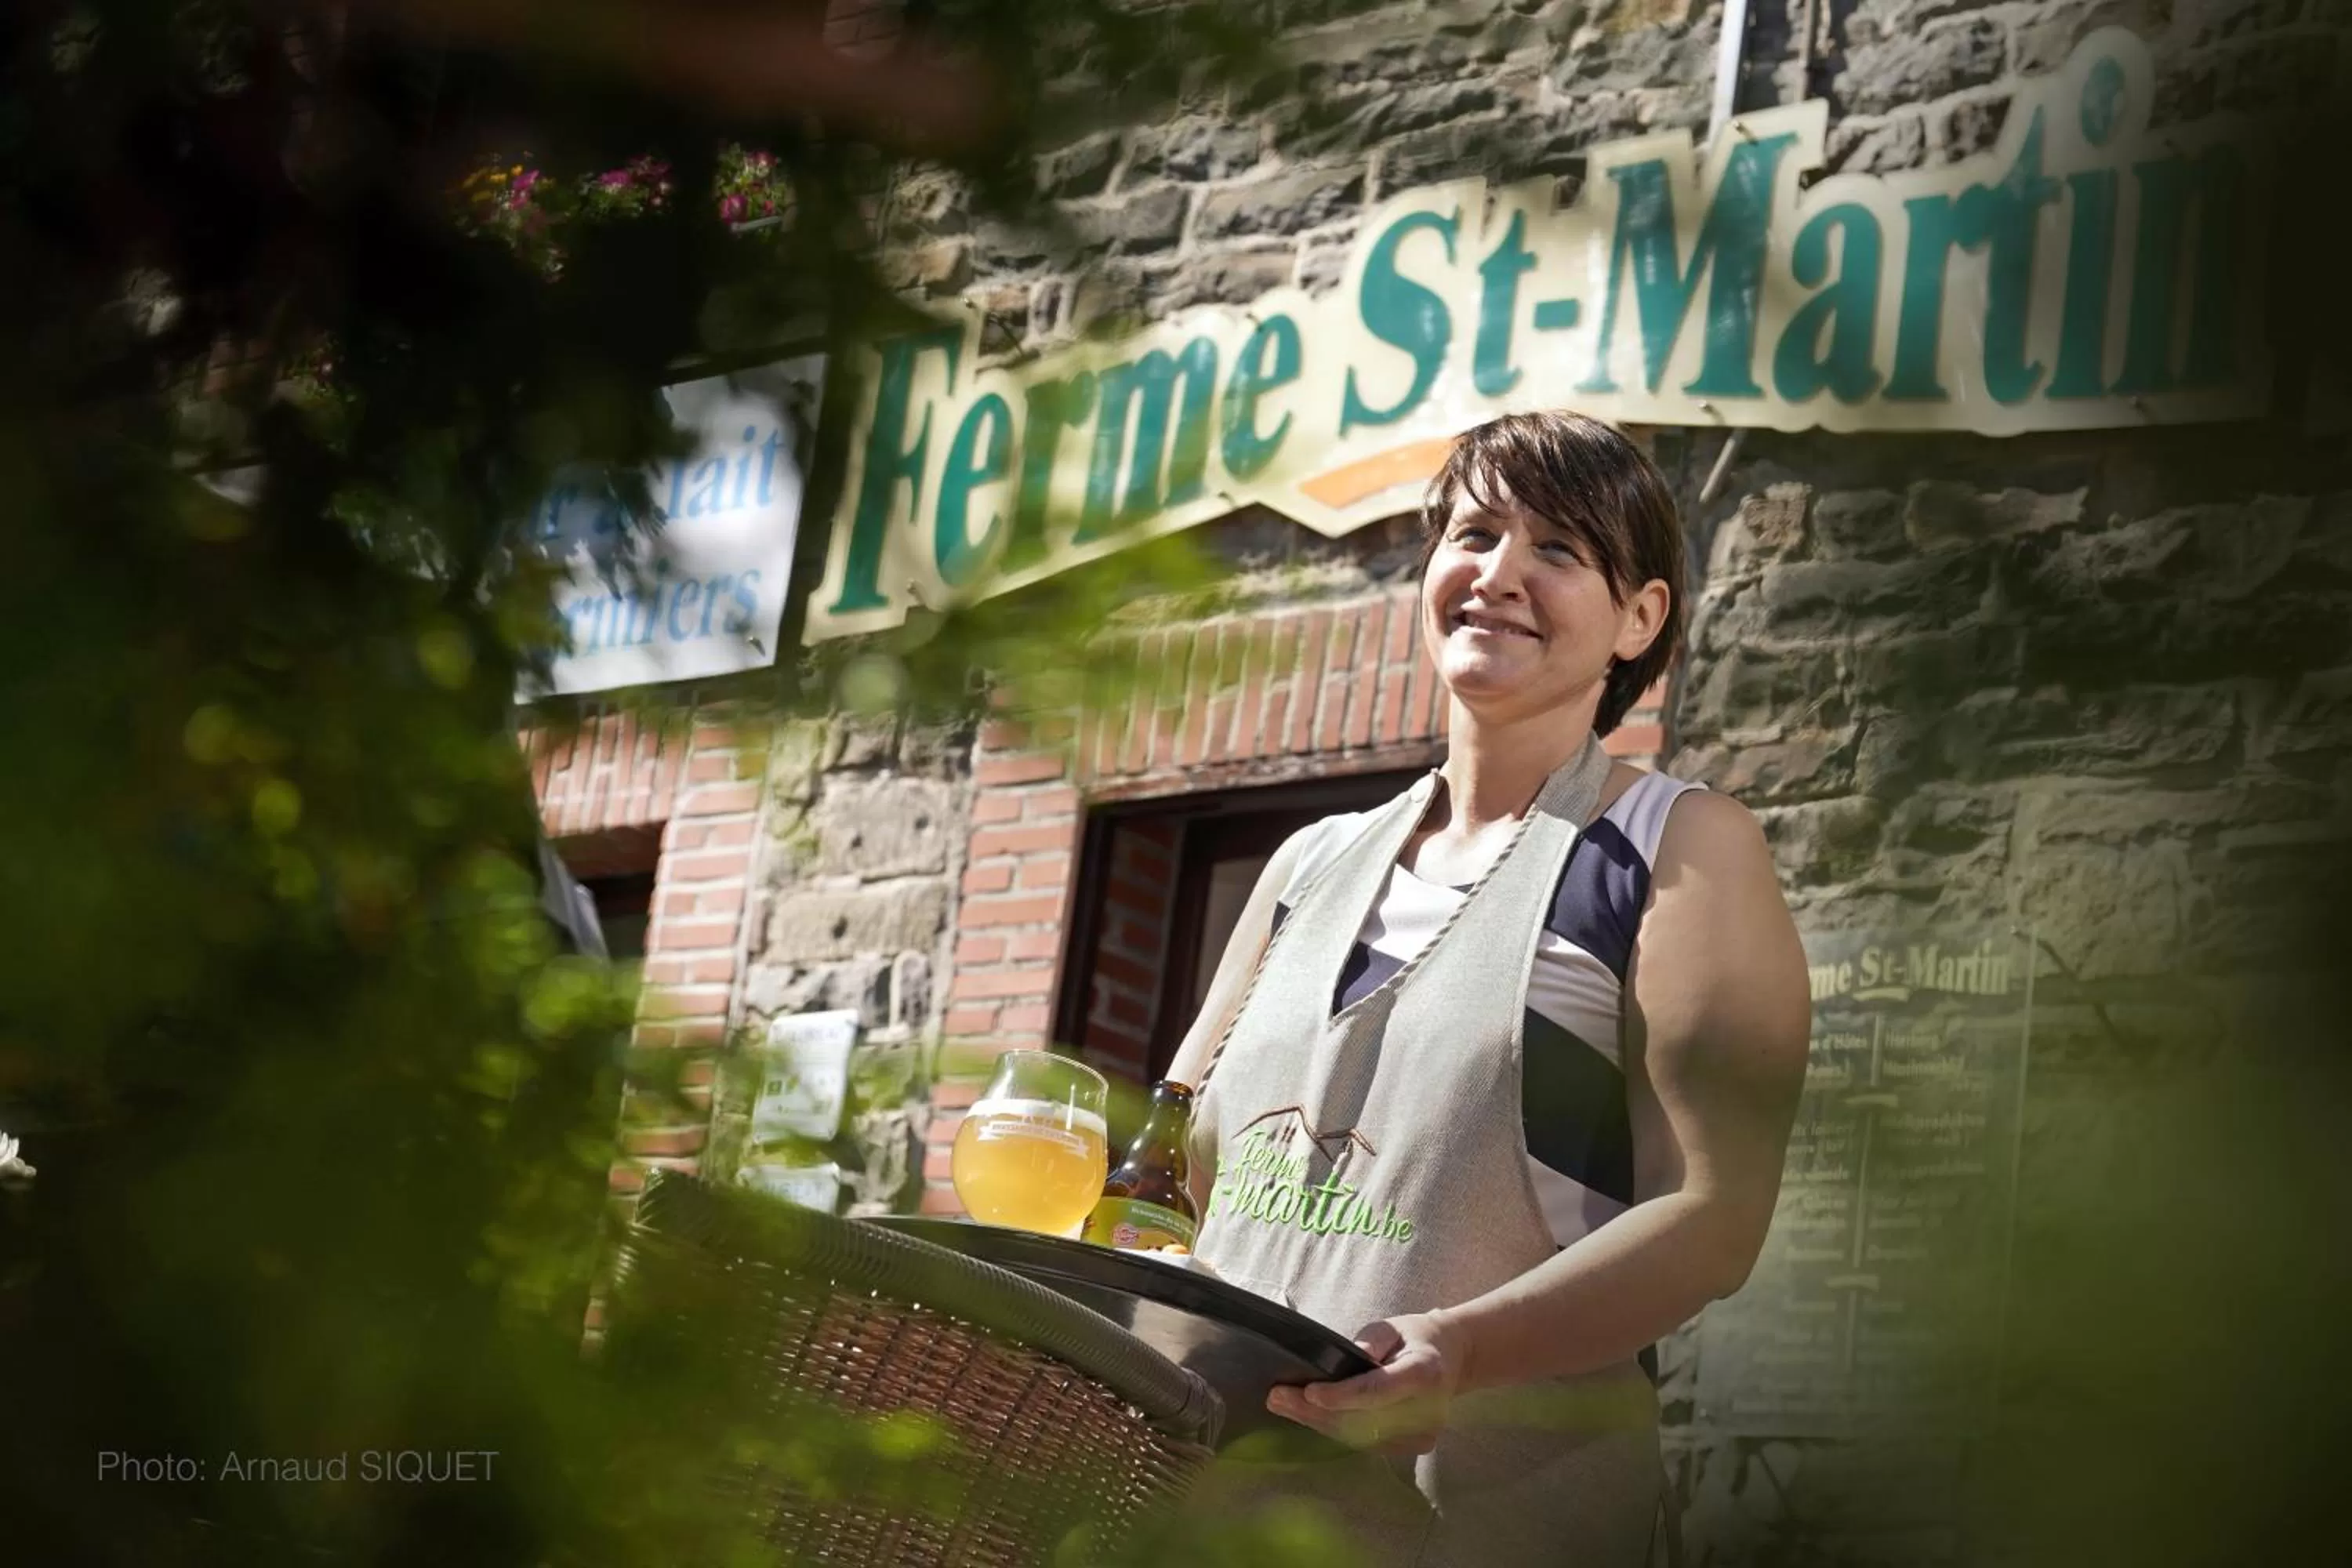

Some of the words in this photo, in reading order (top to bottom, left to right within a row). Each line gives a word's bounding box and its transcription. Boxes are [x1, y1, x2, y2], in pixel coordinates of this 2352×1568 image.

[827, 312, 1303, 616] Ferme
[1338, 55, 2249, 436] St-Martin
[558, 559, 761, 658] rmiers
[1859, 938, 2009, 996] St-Martin
